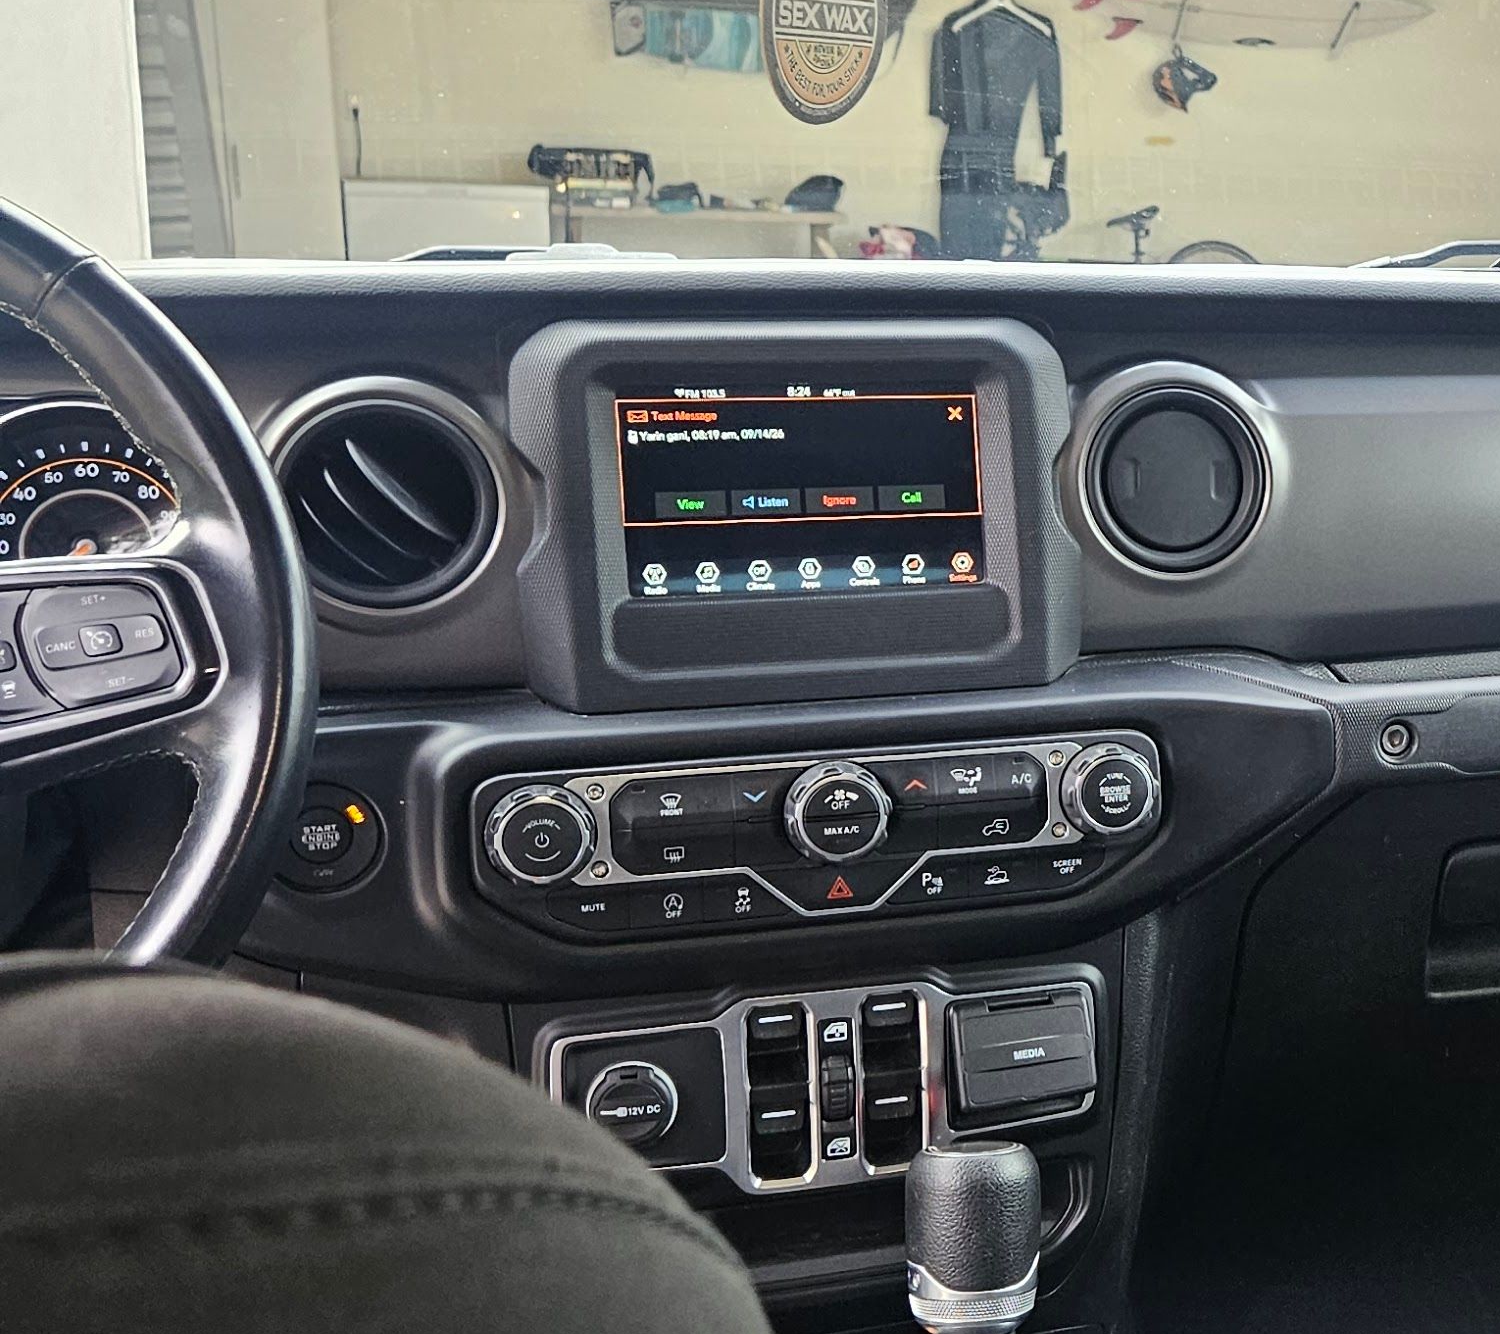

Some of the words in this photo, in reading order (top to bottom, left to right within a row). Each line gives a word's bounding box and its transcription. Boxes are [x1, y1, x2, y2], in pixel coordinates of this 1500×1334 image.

[779, 0, 821, 29] SEX
[823, 3, 870, 34] WAX
[794, 68, 812, 92] BEST
[786, 385, 812, 398] 8:24
[650, 410, 674, 421] Text
[74, 463, 100, 478] 60
[44, 471, 64, 484] 50
[112, 471, 131, 483] 70
[12, 486, 37, 501] 40
[137, 485, 161, 500] 80
[901, 491, 923, 504] Call
[676, 498, 705, 511] View
[757, 496, 789, 508] Listen
[822, 495, 857, 507] Ignore
[800, 579, 821, 589] Apps
[134, 628, 155, 639] RES
[45, 640, 76, 654] CANC
[1011, 772, 1033, 785] A/C
[957, 786, 978, 795] MODE
[1099, 784, 1132, 795] BROWSE
[1104, 794, 1129, 803] ENTER
[831, 800, 851, 811] OFF
[659, 807, 684, 817] FRONT
[526, 818, 556, 829] VOLUME
[303, 824, 337, 835] START
[824, 826, 843, 836] MAX
[843, 825, 860, 835] A/C
[301, 831, 341, 845] ENGINE
[308, 842, 338, 851] STOP
[1053, 858, 1083, 868] SCREEN
[1059, 865, 1076, 875] OFF
[926, 885, 944, 896] OFF
[580, 902, 606, 913] MUTE
[735, 904, 752, 914] OFF
[665, 909, 683, 919] OFF
[1012, 1046, 1046, 1061] MEDIA
[628, 1105, 645, 1116] 12V
[646, 1104, 661, 1114] DC
